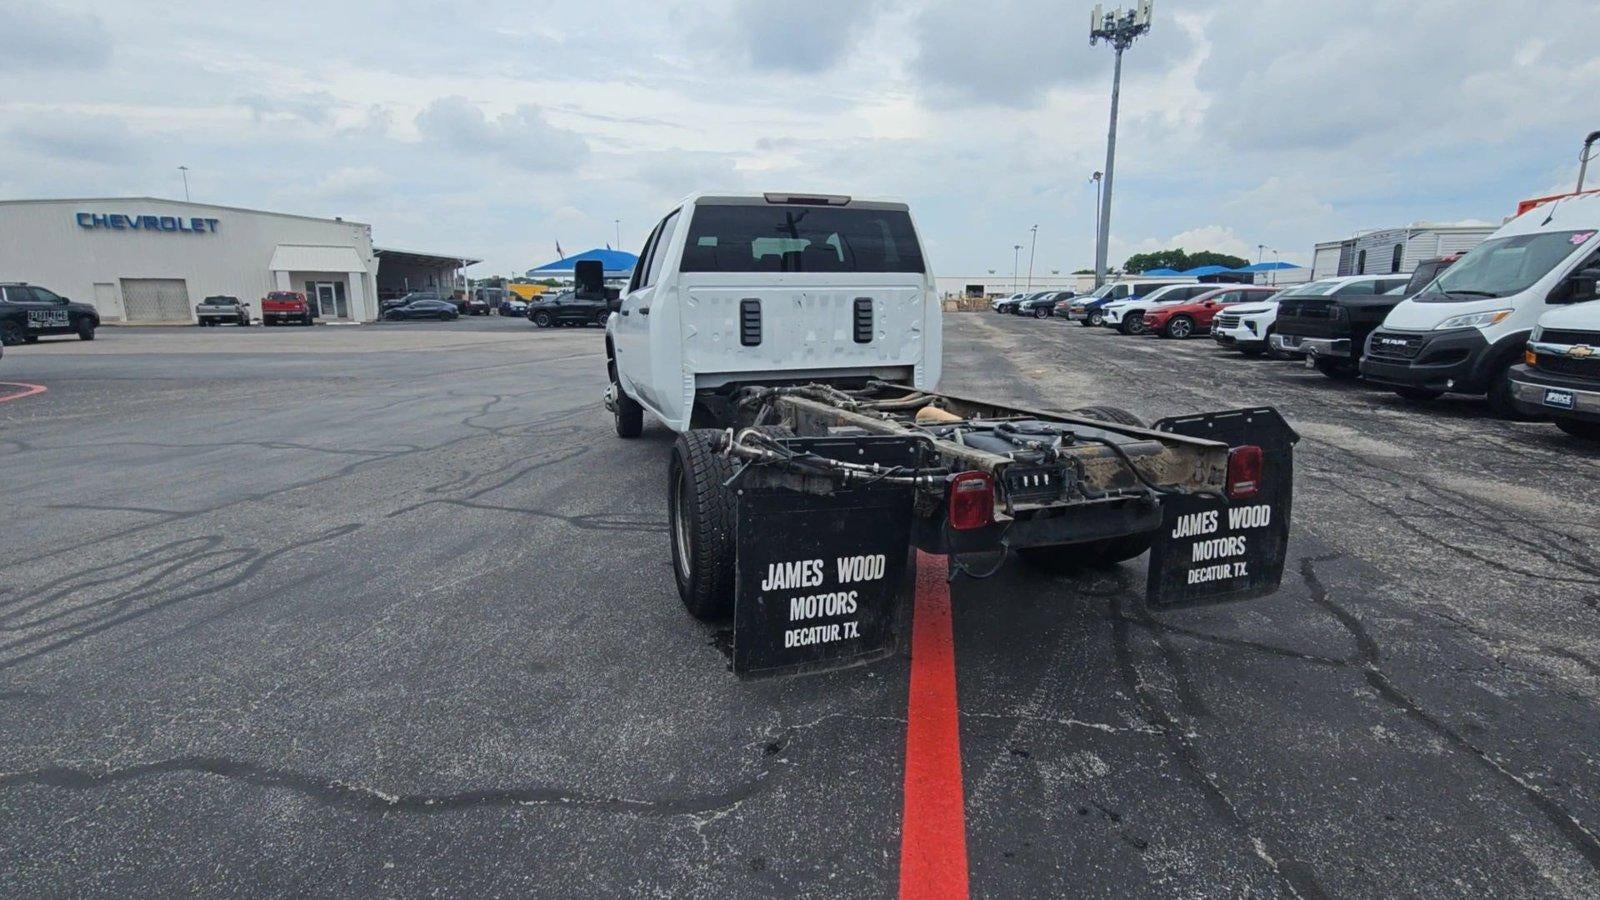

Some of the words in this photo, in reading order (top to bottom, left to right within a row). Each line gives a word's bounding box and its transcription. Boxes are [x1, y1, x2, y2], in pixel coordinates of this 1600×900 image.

[76, 212, 220, 233] CHEVROLET
[28, 310, 68, 321] POLICE
[1172, 509, 1219, 538] JAMES
[1228, 504, 1271, 530] WOOD
[1192, 536, 1246, 562] MOTORS
[761, 558, 824, 591] JAMES
[837, 554, 886, 584] WOOD
[789, 590, 858, 622] MOTORS
[843, 621, 861, 640] TX.
